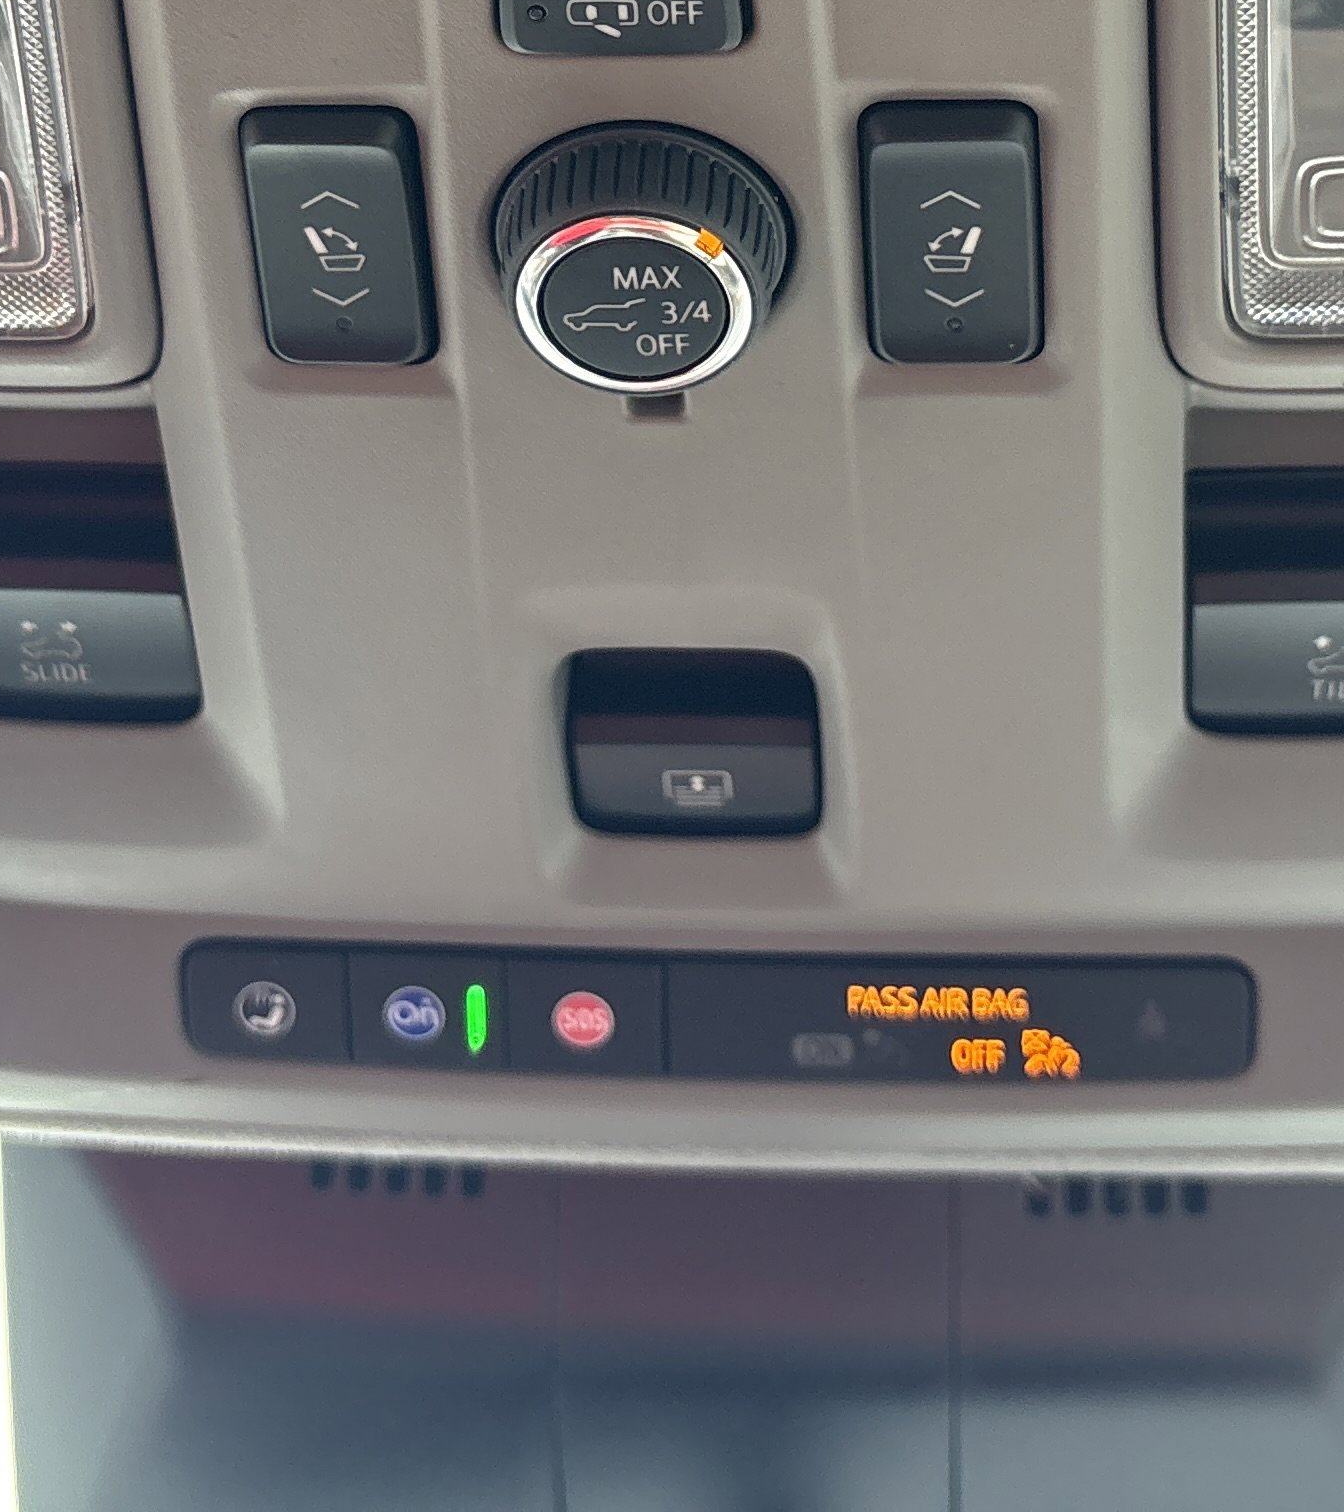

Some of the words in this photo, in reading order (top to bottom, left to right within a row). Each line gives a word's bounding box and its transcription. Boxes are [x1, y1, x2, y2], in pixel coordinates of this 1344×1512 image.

[646, 0, 705, 26] OFF
[612, 265, 684, 291] MAX
[660, 300, 712, 325] 3/4
[635, 333, 691, 357] OFF
[846, 984, 919, 1020] PASS
[919, 985, 970, 1021] AIR
[971, 986, 1031, 1023] BAG
[557, 1005, 610, 1032] SOS
[950, 1038, 1007, 1074] OFF
